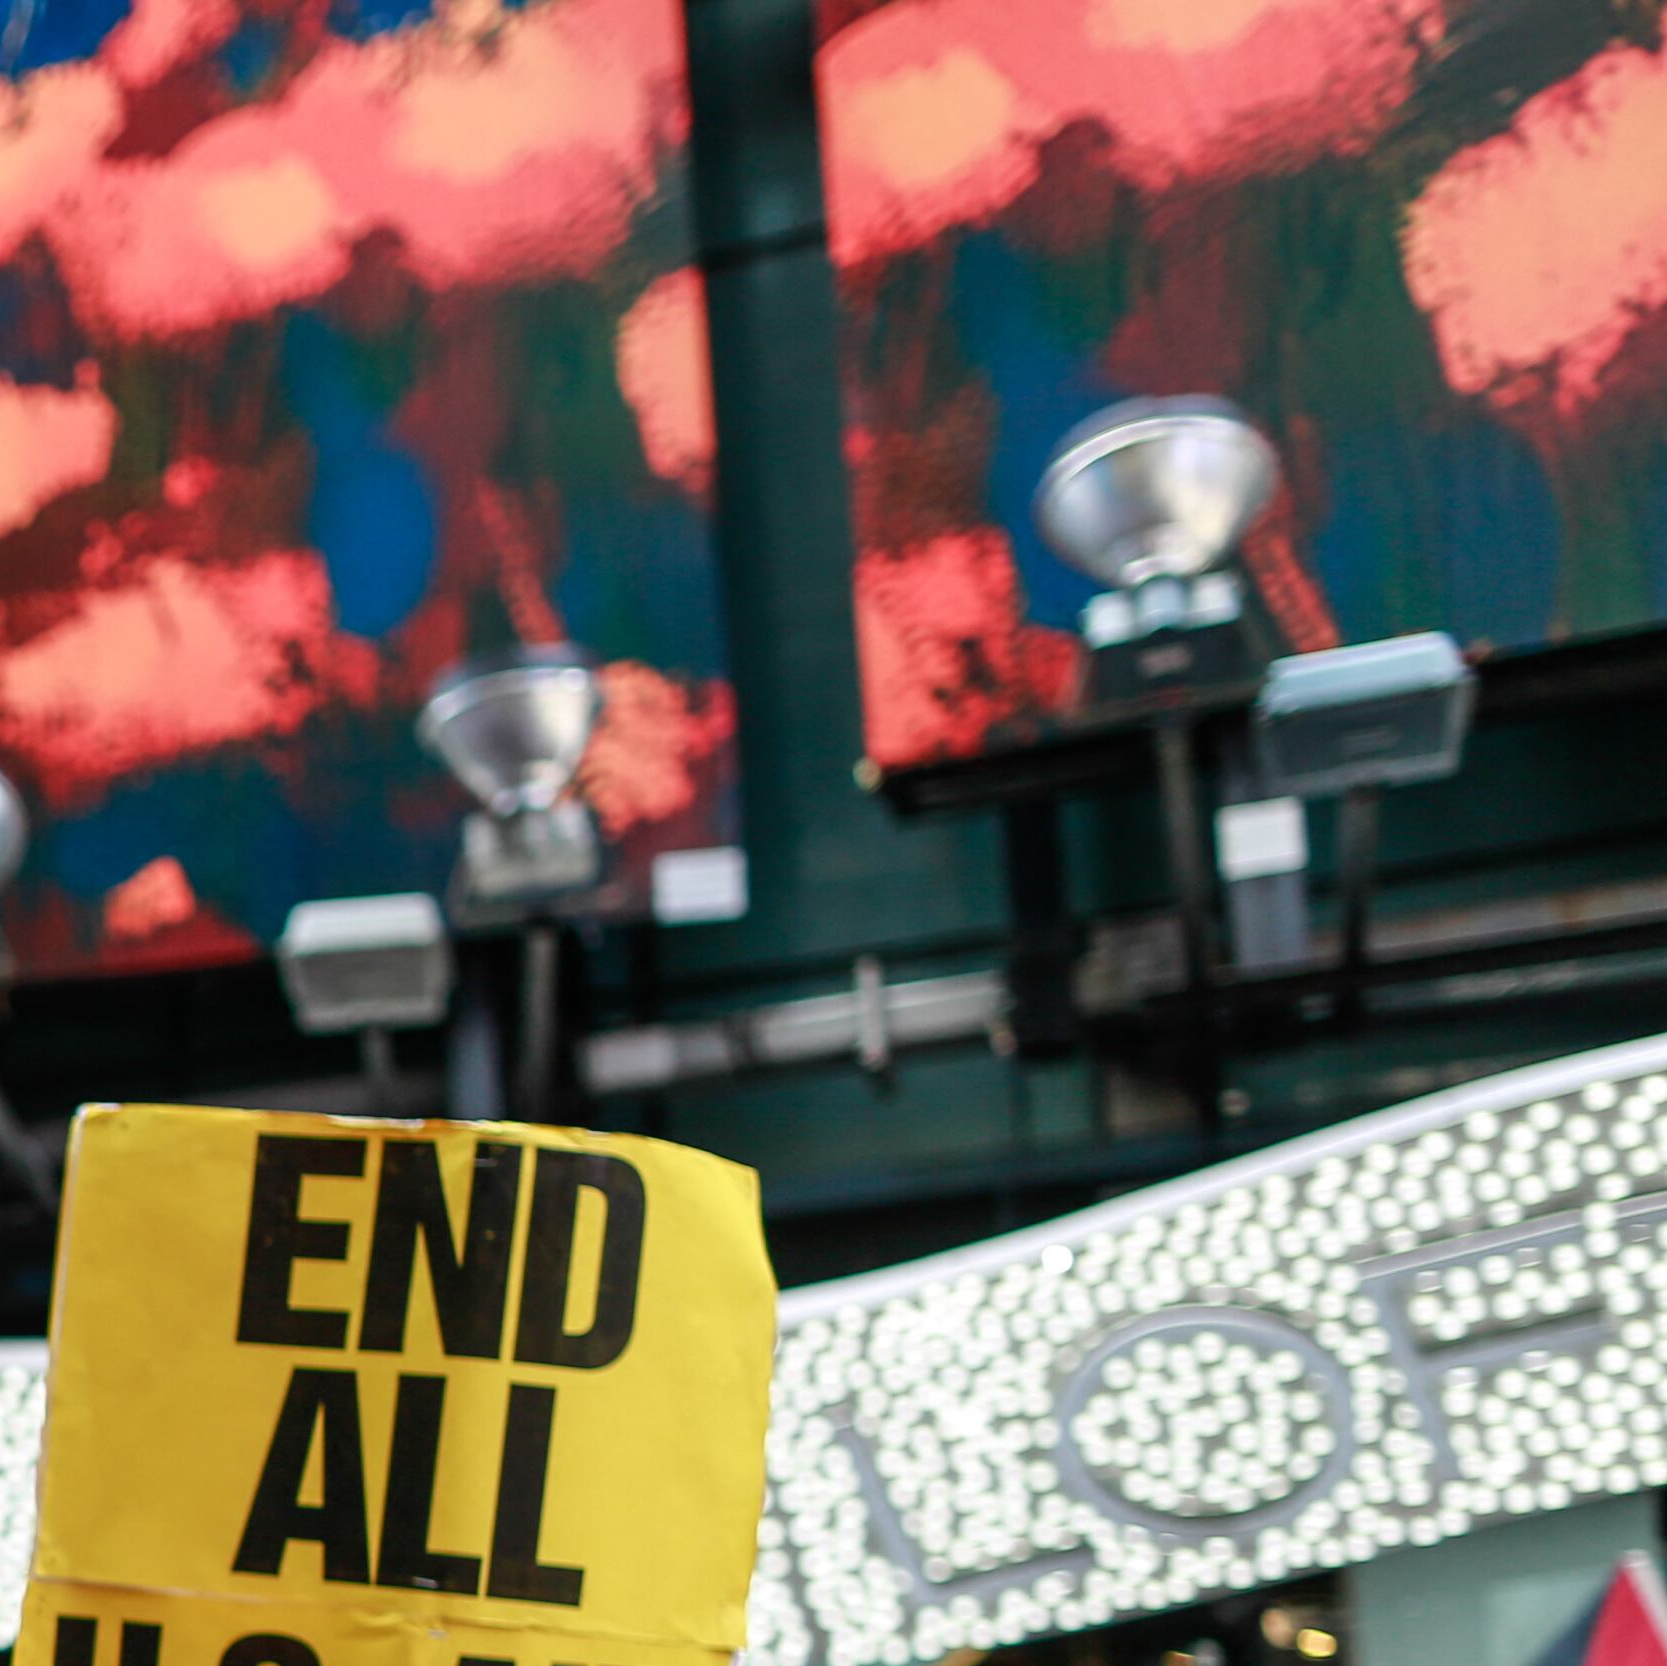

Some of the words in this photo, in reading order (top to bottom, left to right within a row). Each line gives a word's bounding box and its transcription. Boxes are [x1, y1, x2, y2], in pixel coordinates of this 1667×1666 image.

[237, 1133, 647, 1370] END
[231, 1367, 584, 1607] ALL
[827, 1193, 1667, 1604] LOF
